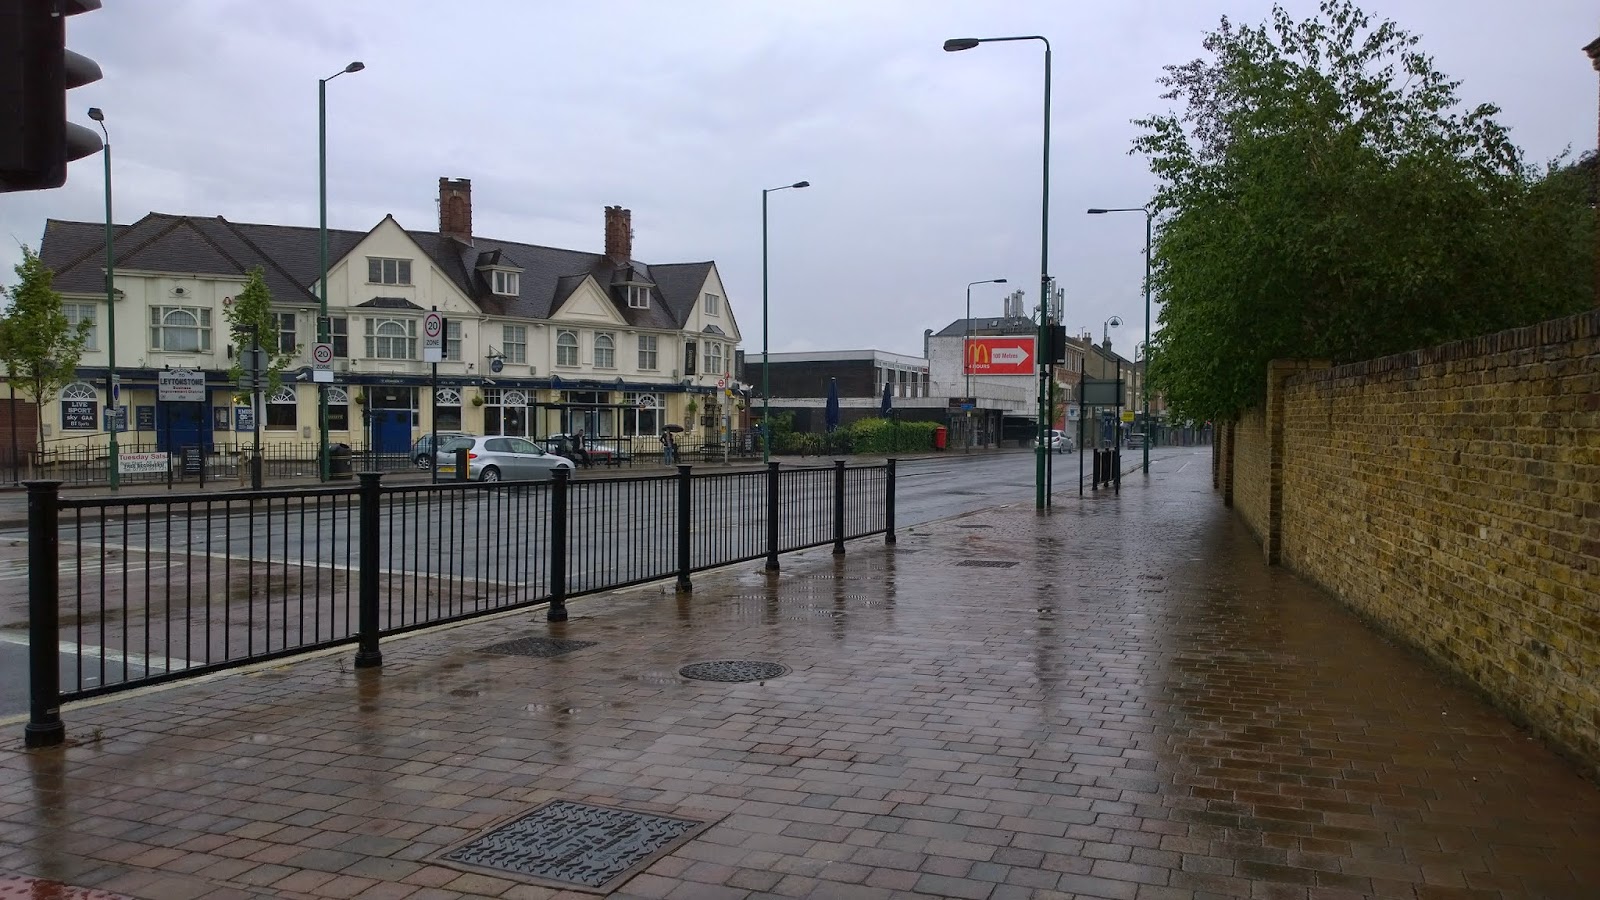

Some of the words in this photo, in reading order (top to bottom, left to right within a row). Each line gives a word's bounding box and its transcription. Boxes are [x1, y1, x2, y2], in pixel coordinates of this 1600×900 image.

[427, 321, 438, 331] 20
[170, 368, 194, 376] WELCOME
[160, 378, 204, 386] LEYTONSTONE
